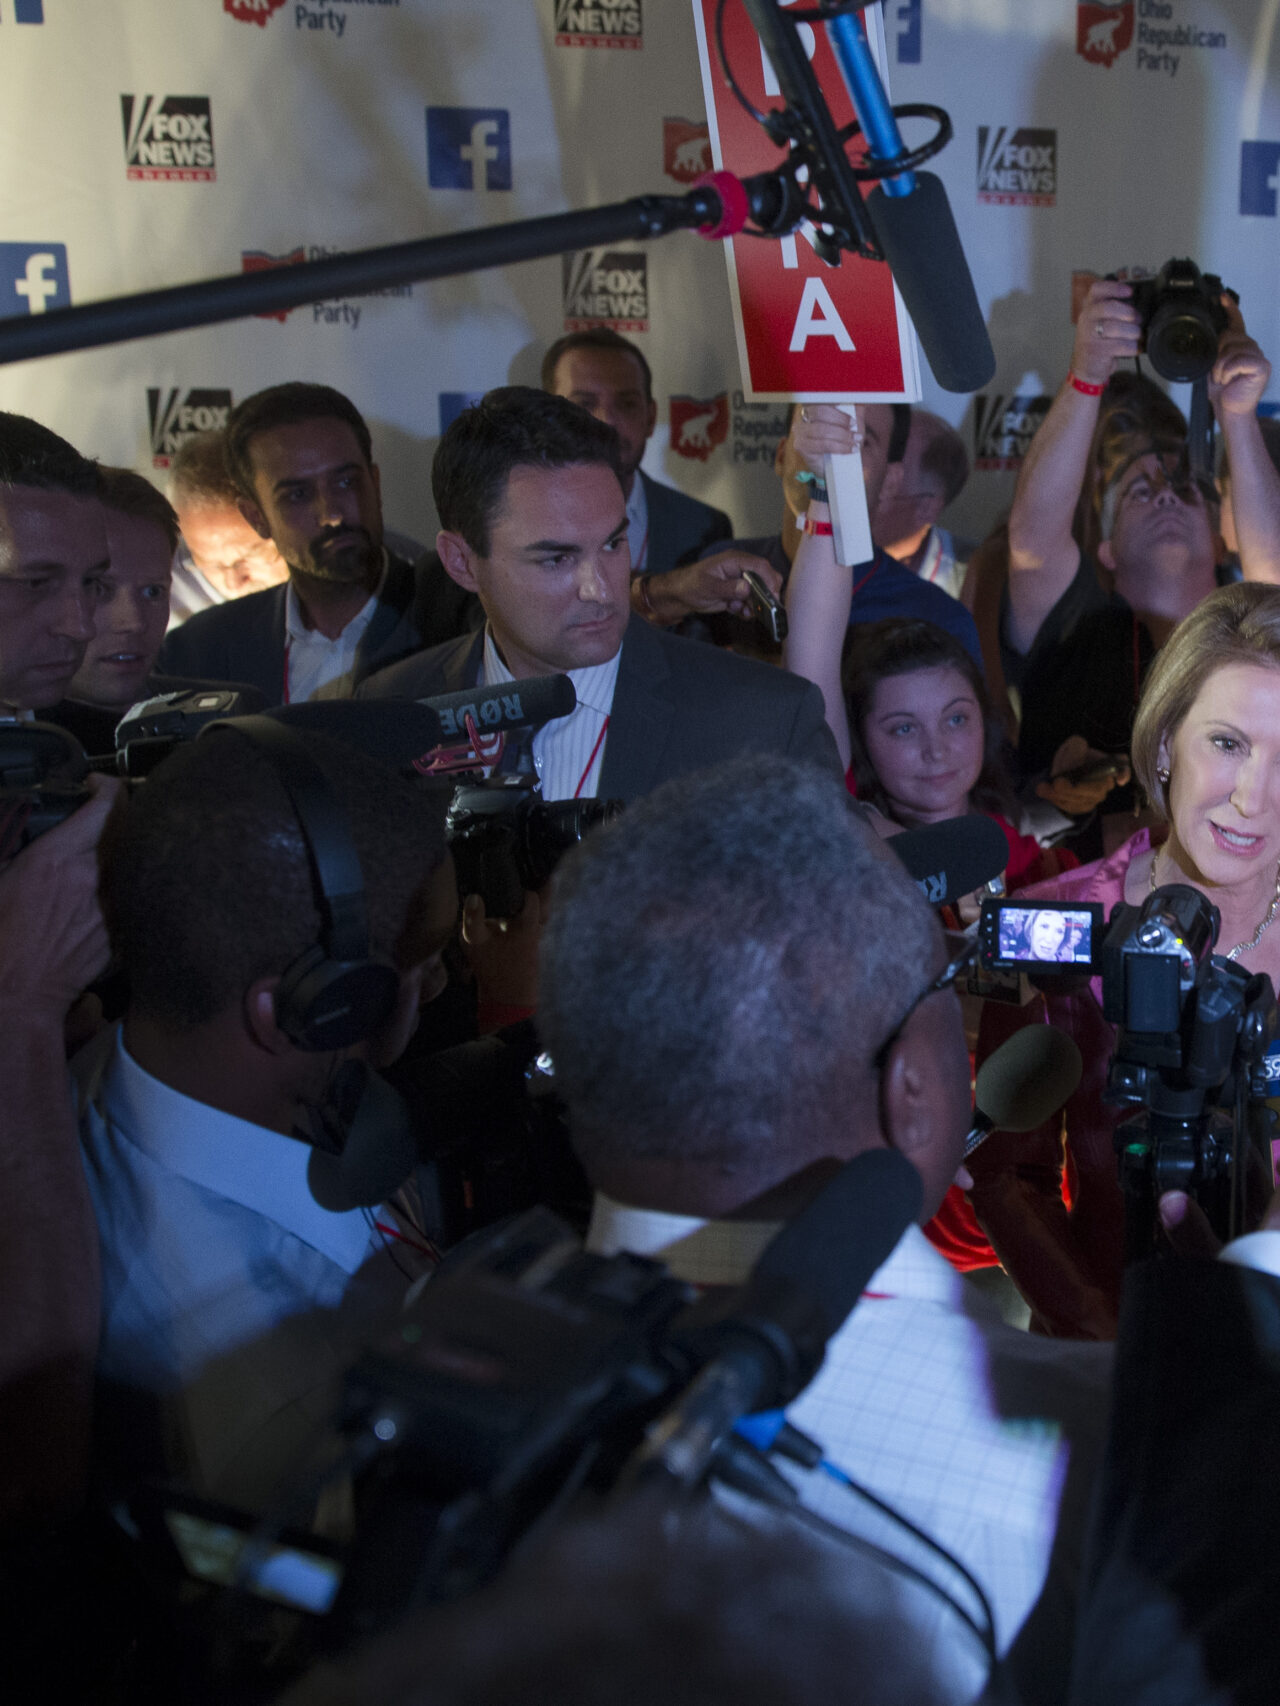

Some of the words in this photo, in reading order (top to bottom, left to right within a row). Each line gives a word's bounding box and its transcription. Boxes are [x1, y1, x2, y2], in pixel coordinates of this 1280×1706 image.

[296, 5, 346, 37] Party
[567, 9, 641, 35] NEWS
[1139, 22, 1227, 49] Republican
[1138, 49, 1180, 77] Party
[152, 114, 212, 141] FOX
[138, 141, 213, 166] NEWS
[1003, 143, 1056, 170] FOX
[987, 168, 1056, 193] NEWS
[592, 269, 647, 295] FOX
[313, 301, 361, 329] Party
[575, 294, 647, 319] NEWS
[178, 405, 230, 432] FOX
